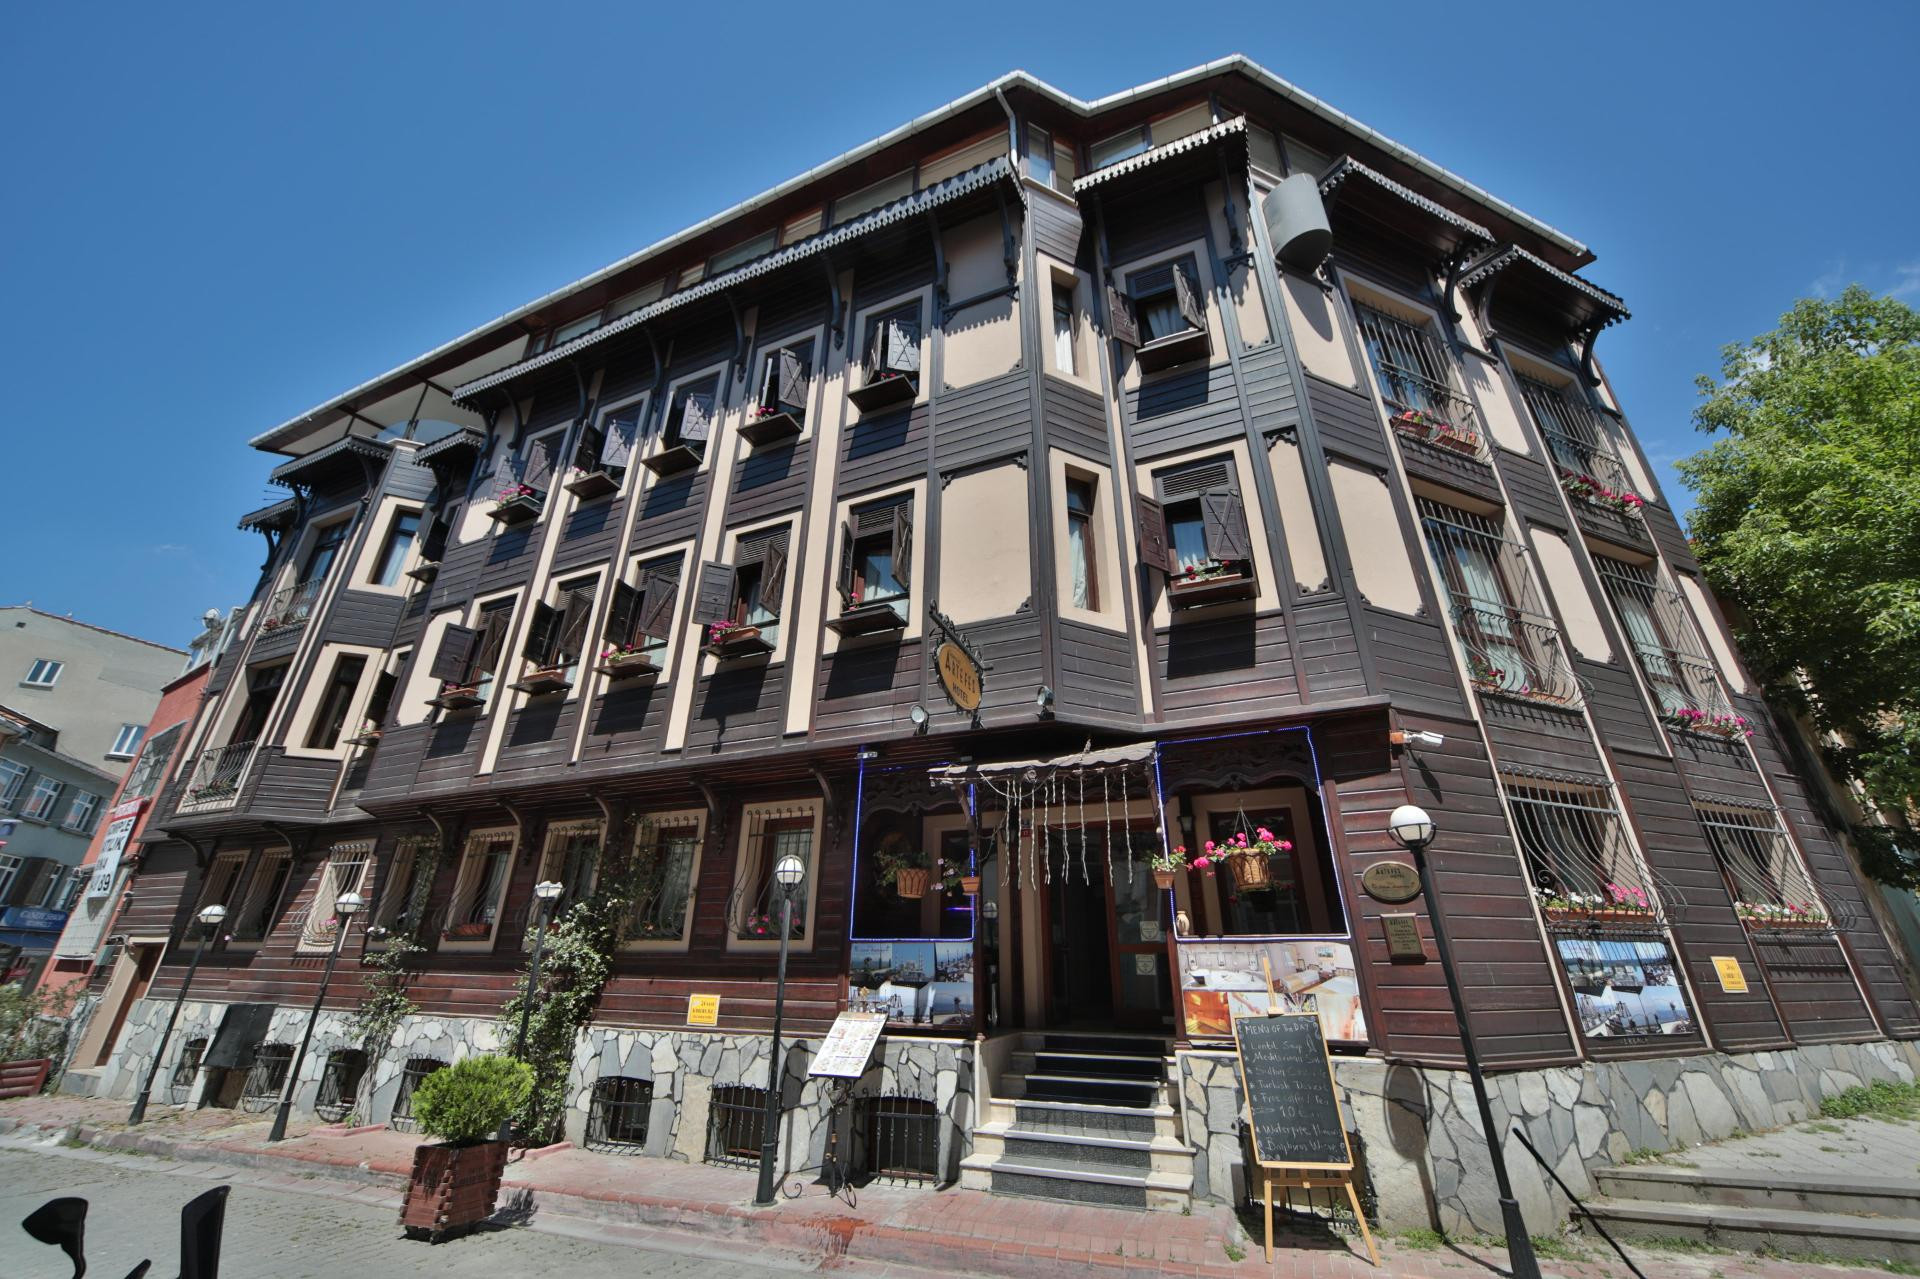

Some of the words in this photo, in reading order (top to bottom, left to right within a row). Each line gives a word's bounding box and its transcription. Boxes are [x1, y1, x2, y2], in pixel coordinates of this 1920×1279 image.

[952, 681, 969, 704] HOTEL
[1245, 1025, 1270, 1035] MENU
[1271, 1024, 1281, 1033] OF
